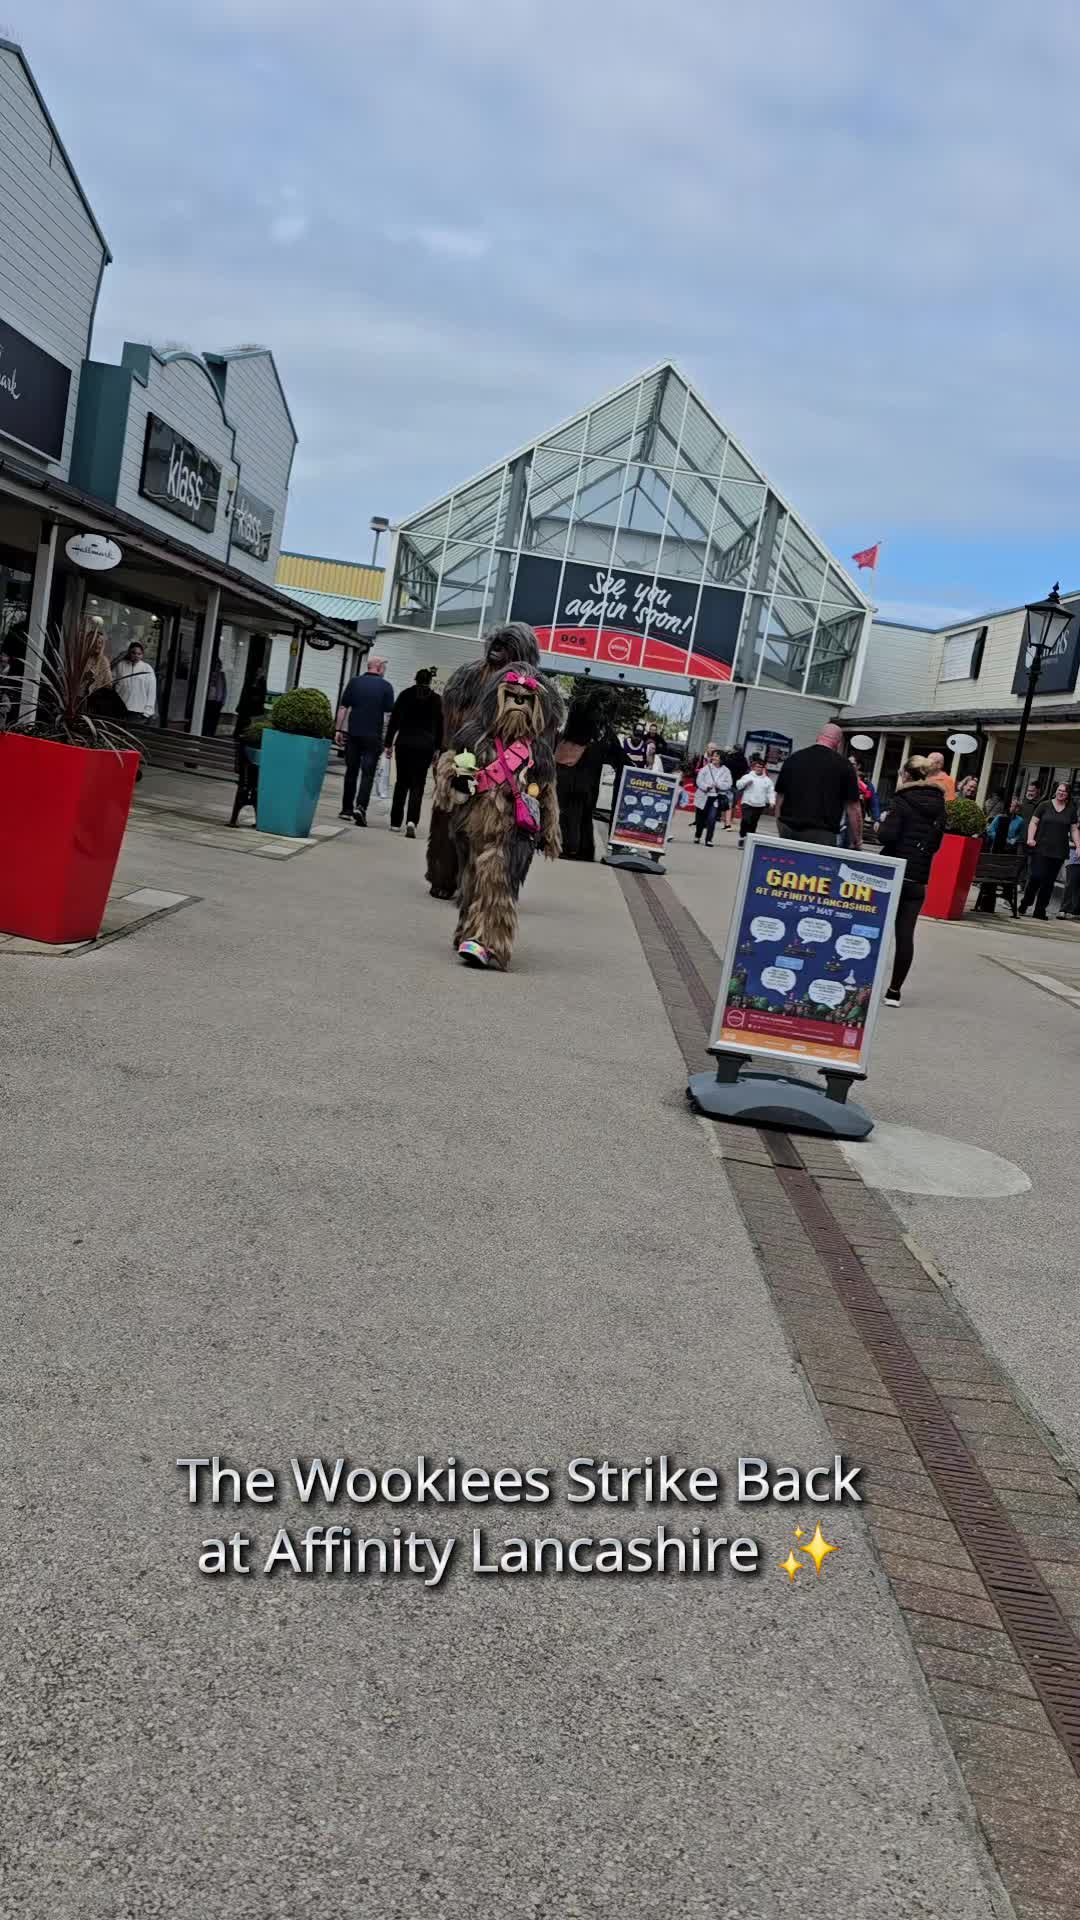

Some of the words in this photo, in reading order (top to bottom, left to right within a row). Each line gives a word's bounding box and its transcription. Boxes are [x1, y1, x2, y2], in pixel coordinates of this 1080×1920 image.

[167, 443, 204, 511] klass
[589, 571, 627, 599] See
[632, 582, 673, 612] you
[565, 598, 628, 627] again
[635, 605, 693, 635] soon!
[755, 885, 769, 896] AT
[770, 887, 816, 904] AFFINITY
[817, 895, 879, 914] LANCASHIRE
[766, 868, 832, 896] GAME
[839, 880, 874, 902] ON
